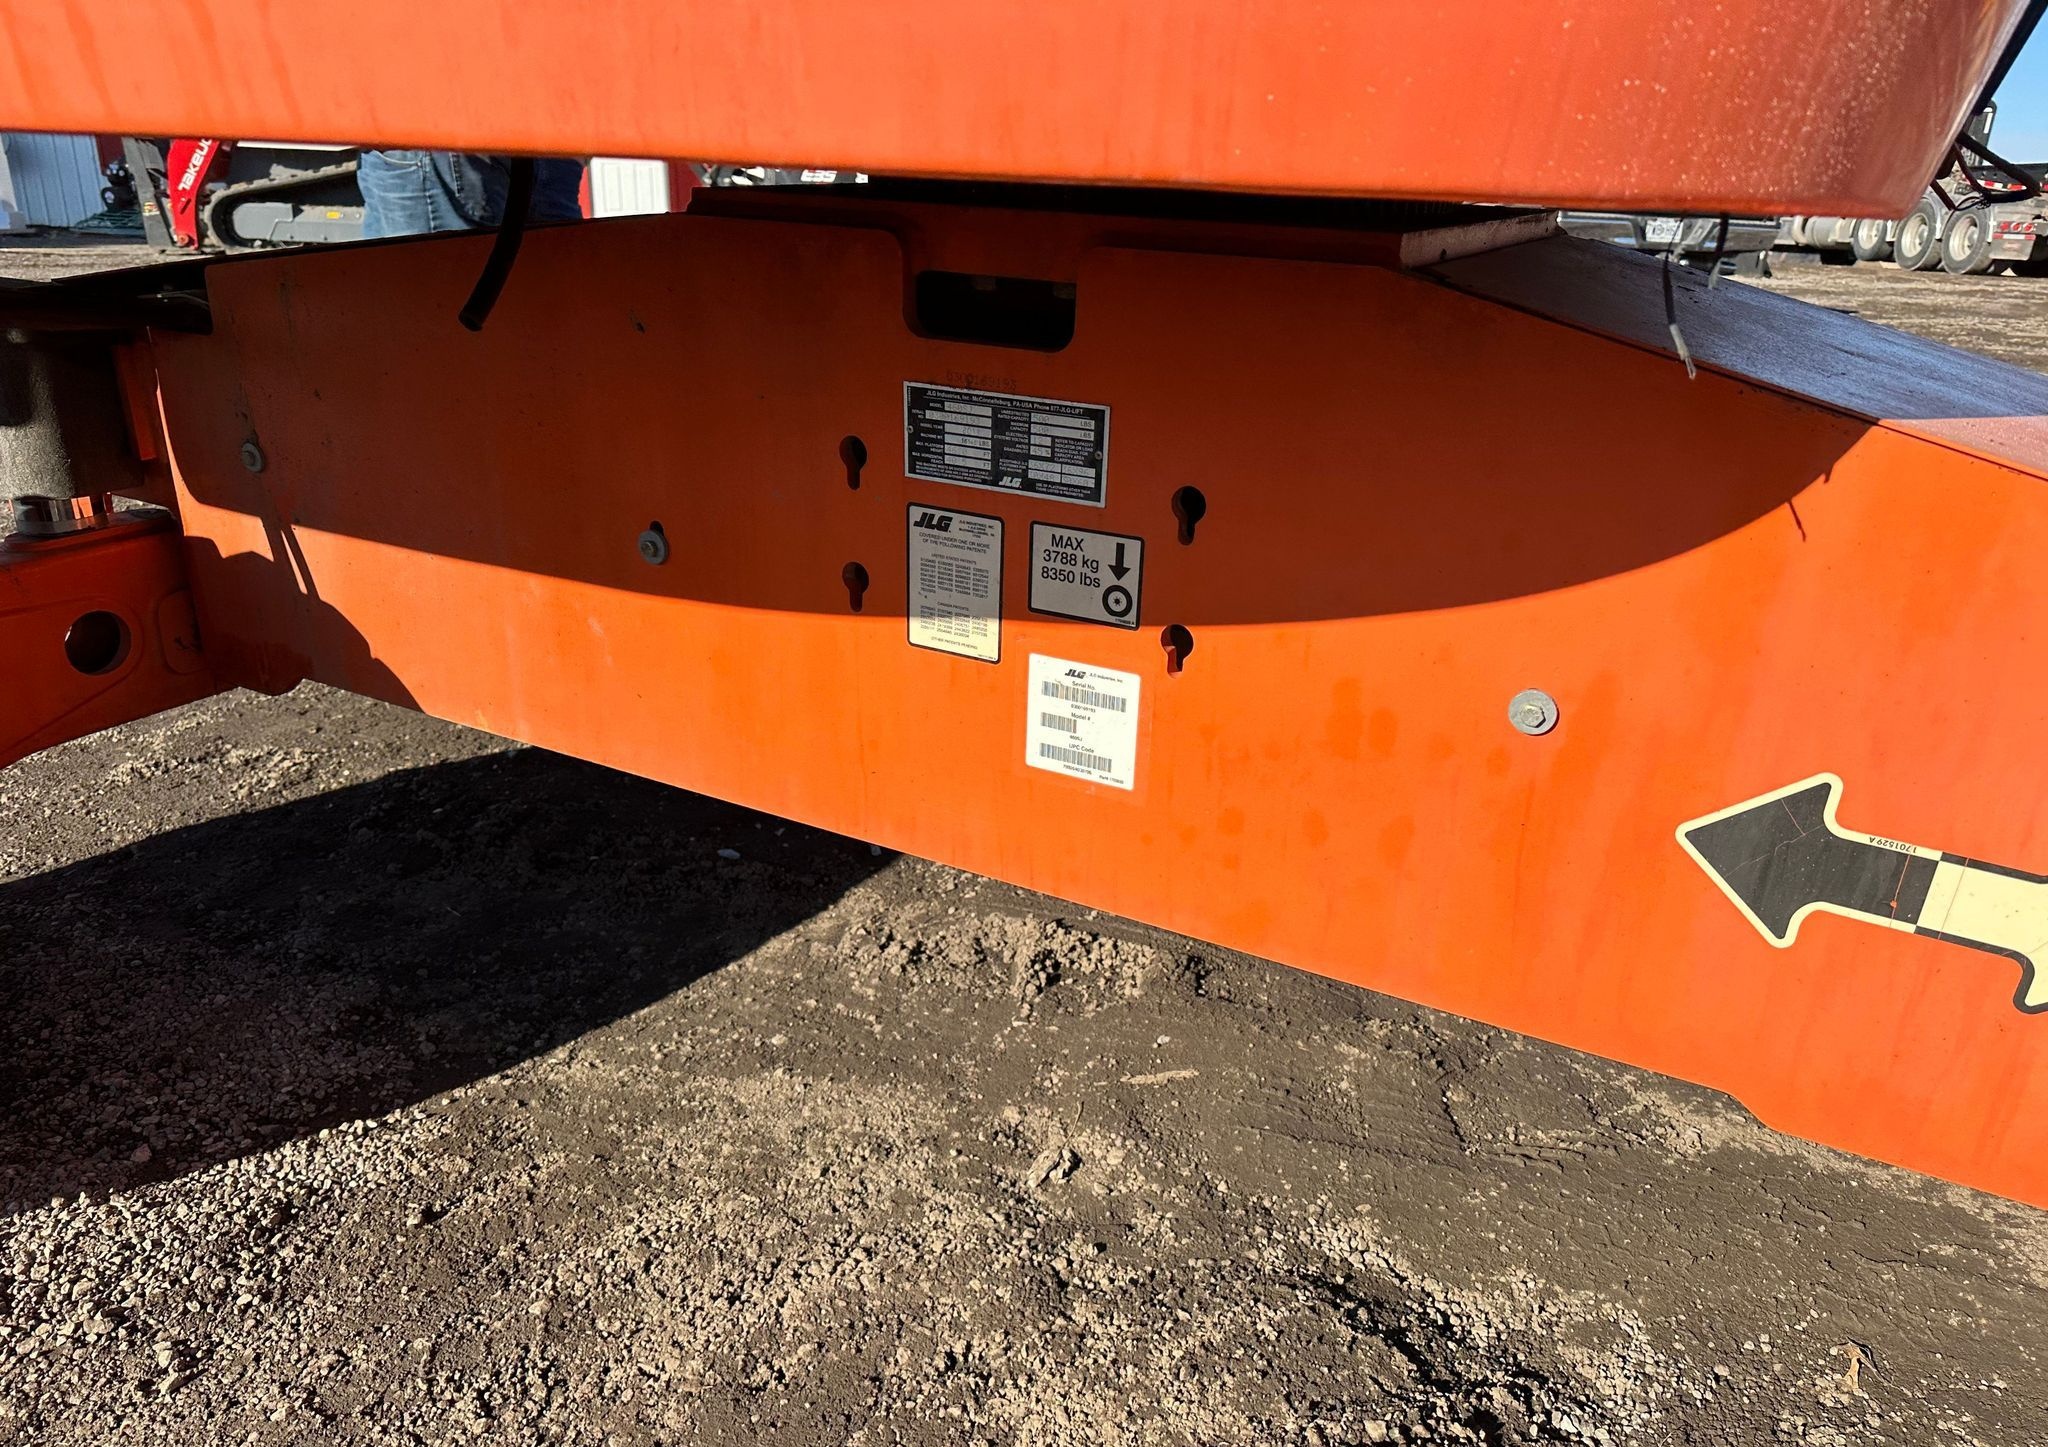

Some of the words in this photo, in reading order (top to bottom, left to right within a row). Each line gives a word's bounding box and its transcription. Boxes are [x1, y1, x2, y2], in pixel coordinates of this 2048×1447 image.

[1080, 420, 1092, 428] LBS
[1080, 431, 1092, 439] LBS
[998, 476, 1022, 488] JLG
[913, 512, 953, 533] JLG
[1051, 534, 1084, 552] MAX
[1043, 549, 1077, 566] 3788
[1082, 554, 1099, 573] kg
[1041, 566, 1076, 584] 8350
[1080, 572, 1100, 588] lbs
[1064, 668, 1086, 680] JLG
[1072, 680, 1086, 689] Serial
[1071, 712, 1087, 721] Model
[1068, 743, 1081, 751] UPC
[1081, 746, 1094, 754] Code
[1876, 840, 1917, 854] 1701529
